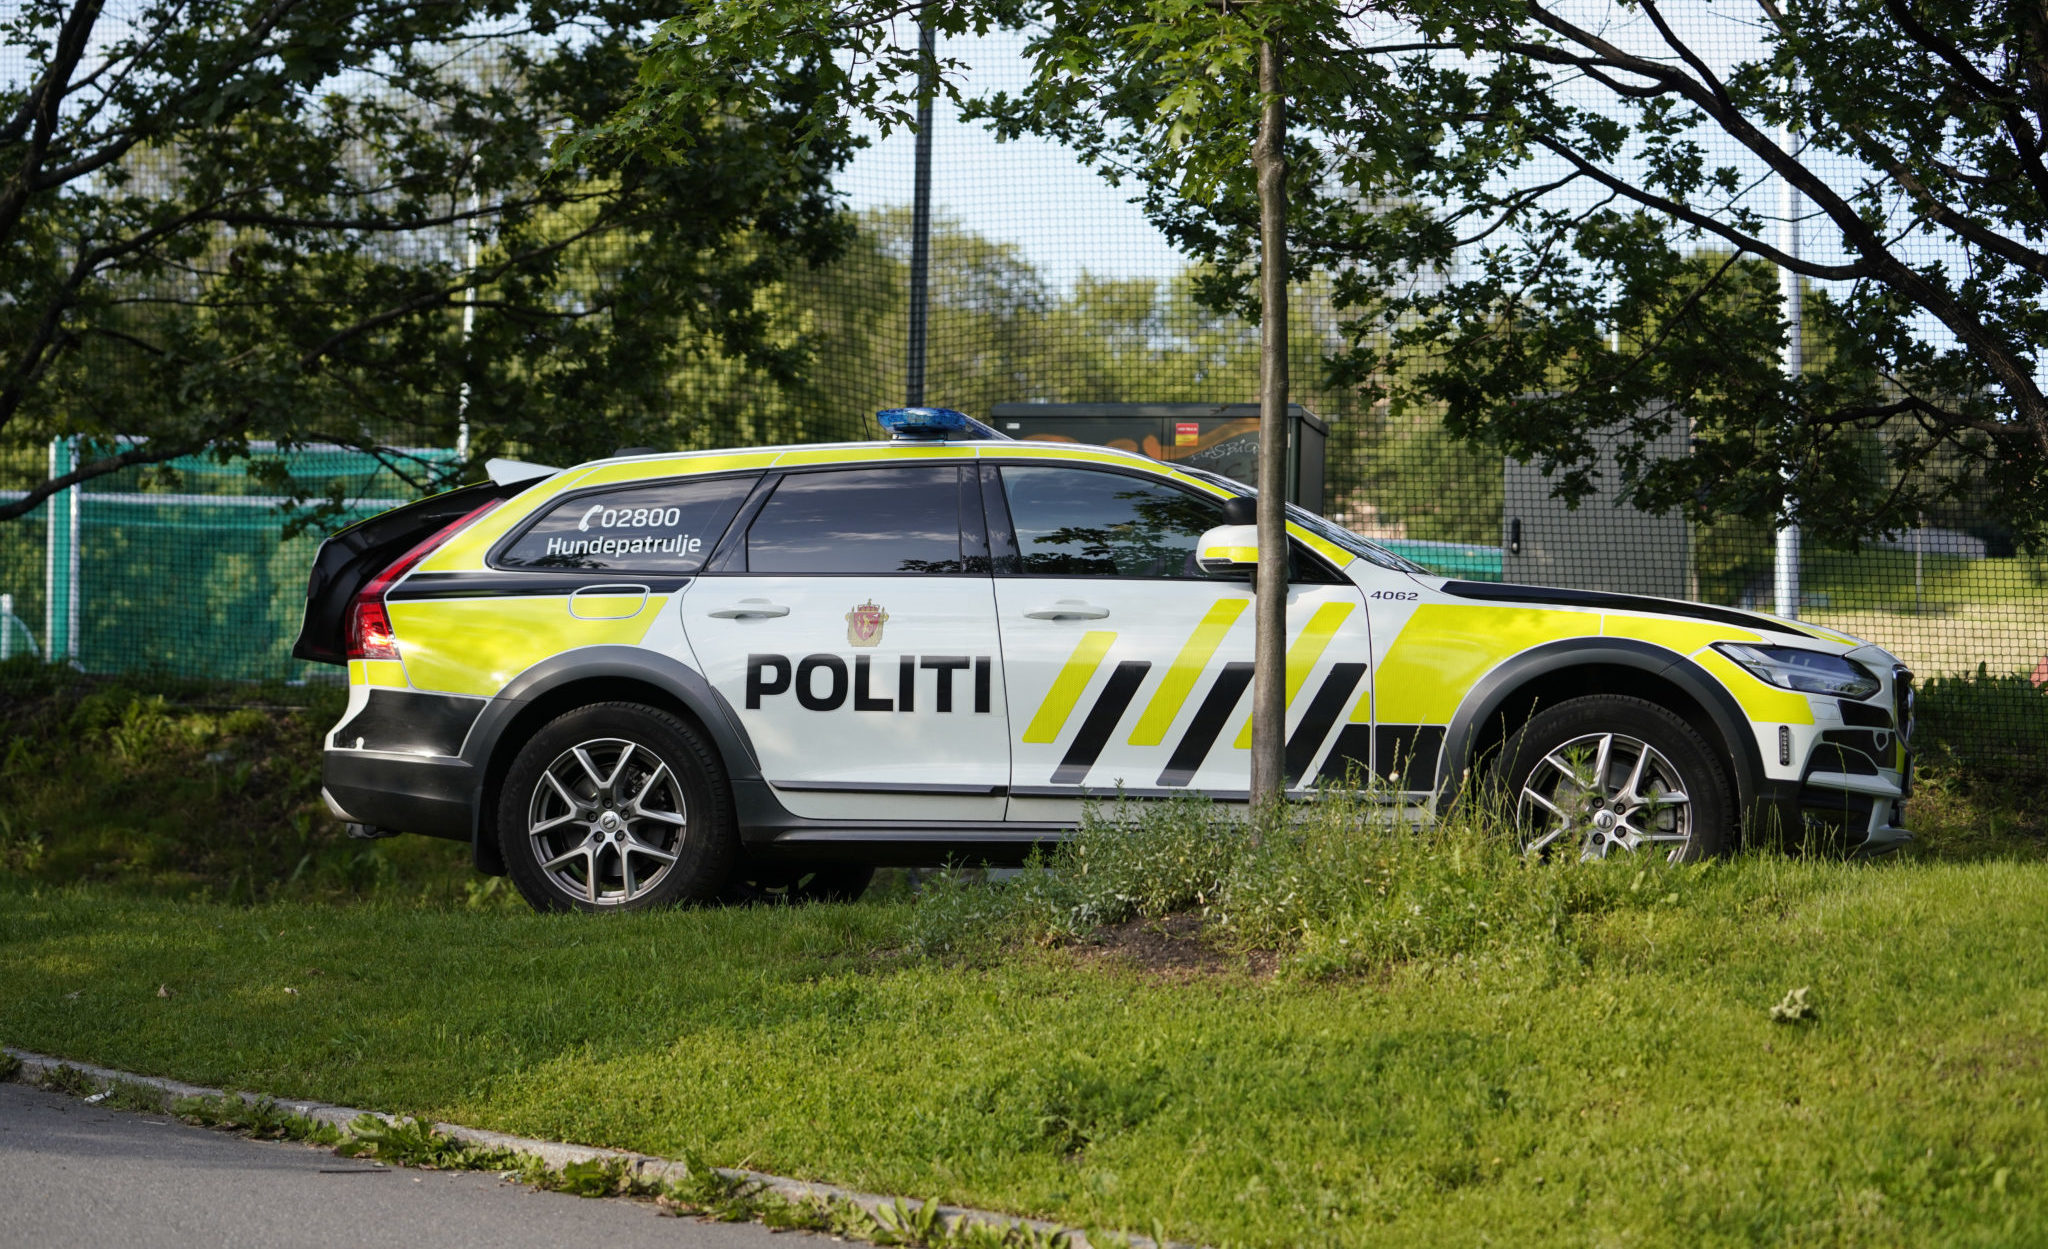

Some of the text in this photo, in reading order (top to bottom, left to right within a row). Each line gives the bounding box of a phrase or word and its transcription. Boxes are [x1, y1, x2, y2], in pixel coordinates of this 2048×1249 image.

[601, 508, 681, 528] 02800
[546, 534, 702, 558] Hundepatrulje
[1369, 590, 1419, 601] 4062
[745, 653, 991, 713] POLITI
